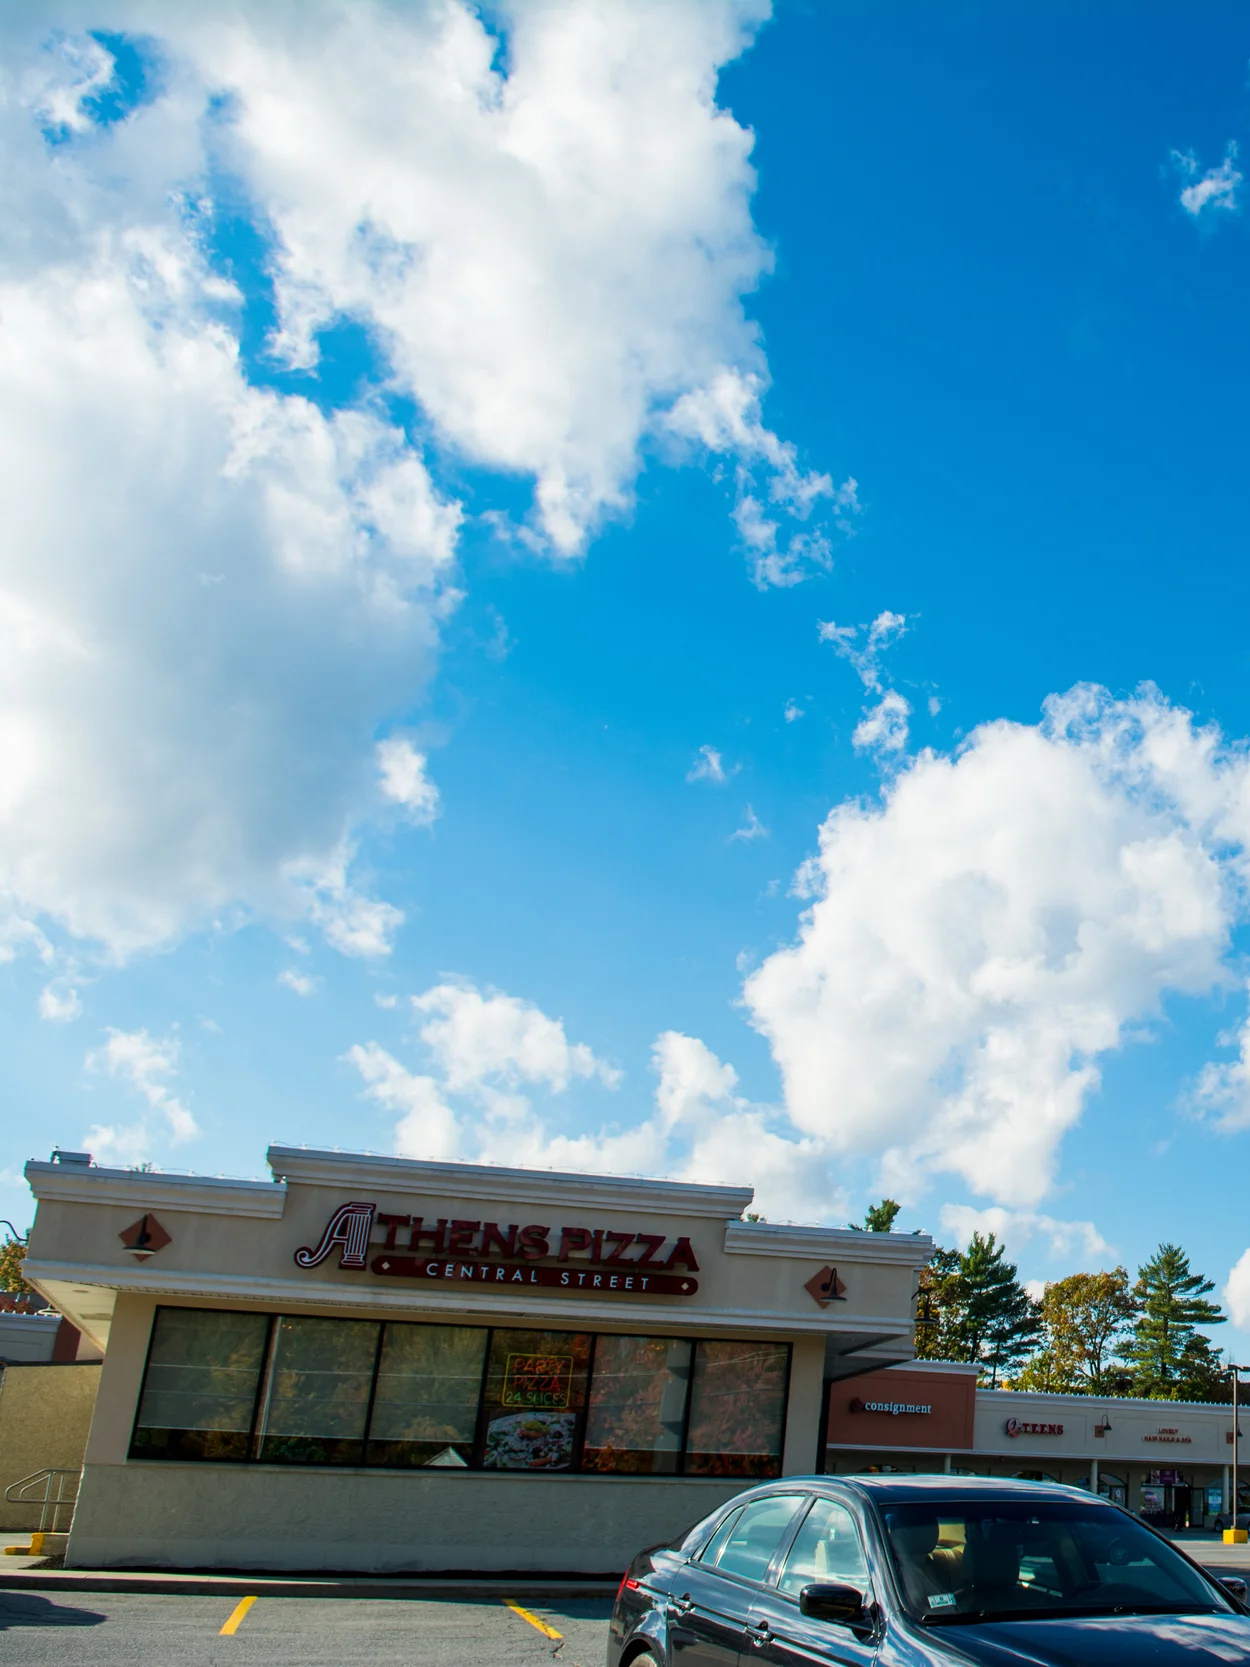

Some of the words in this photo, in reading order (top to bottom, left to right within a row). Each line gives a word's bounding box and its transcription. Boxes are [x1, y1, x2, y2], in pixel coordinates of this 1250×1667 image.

[294, 1202, 550, 1271] ATHENS
[557, 1226, 700, 1273] PIZZA
[426, 1262, 538, 1284] CENTRAL
[561, 1272, 650, 1291] STREET
[513, 1358, 565, 1374] PARTY
[513, 1375, 560, 1391] PIZZA
[506, 1391, 520, 1403] 24
[526, 1391, 567, 1405] SLICES
[865, 1401, 931, 1415] consignment
